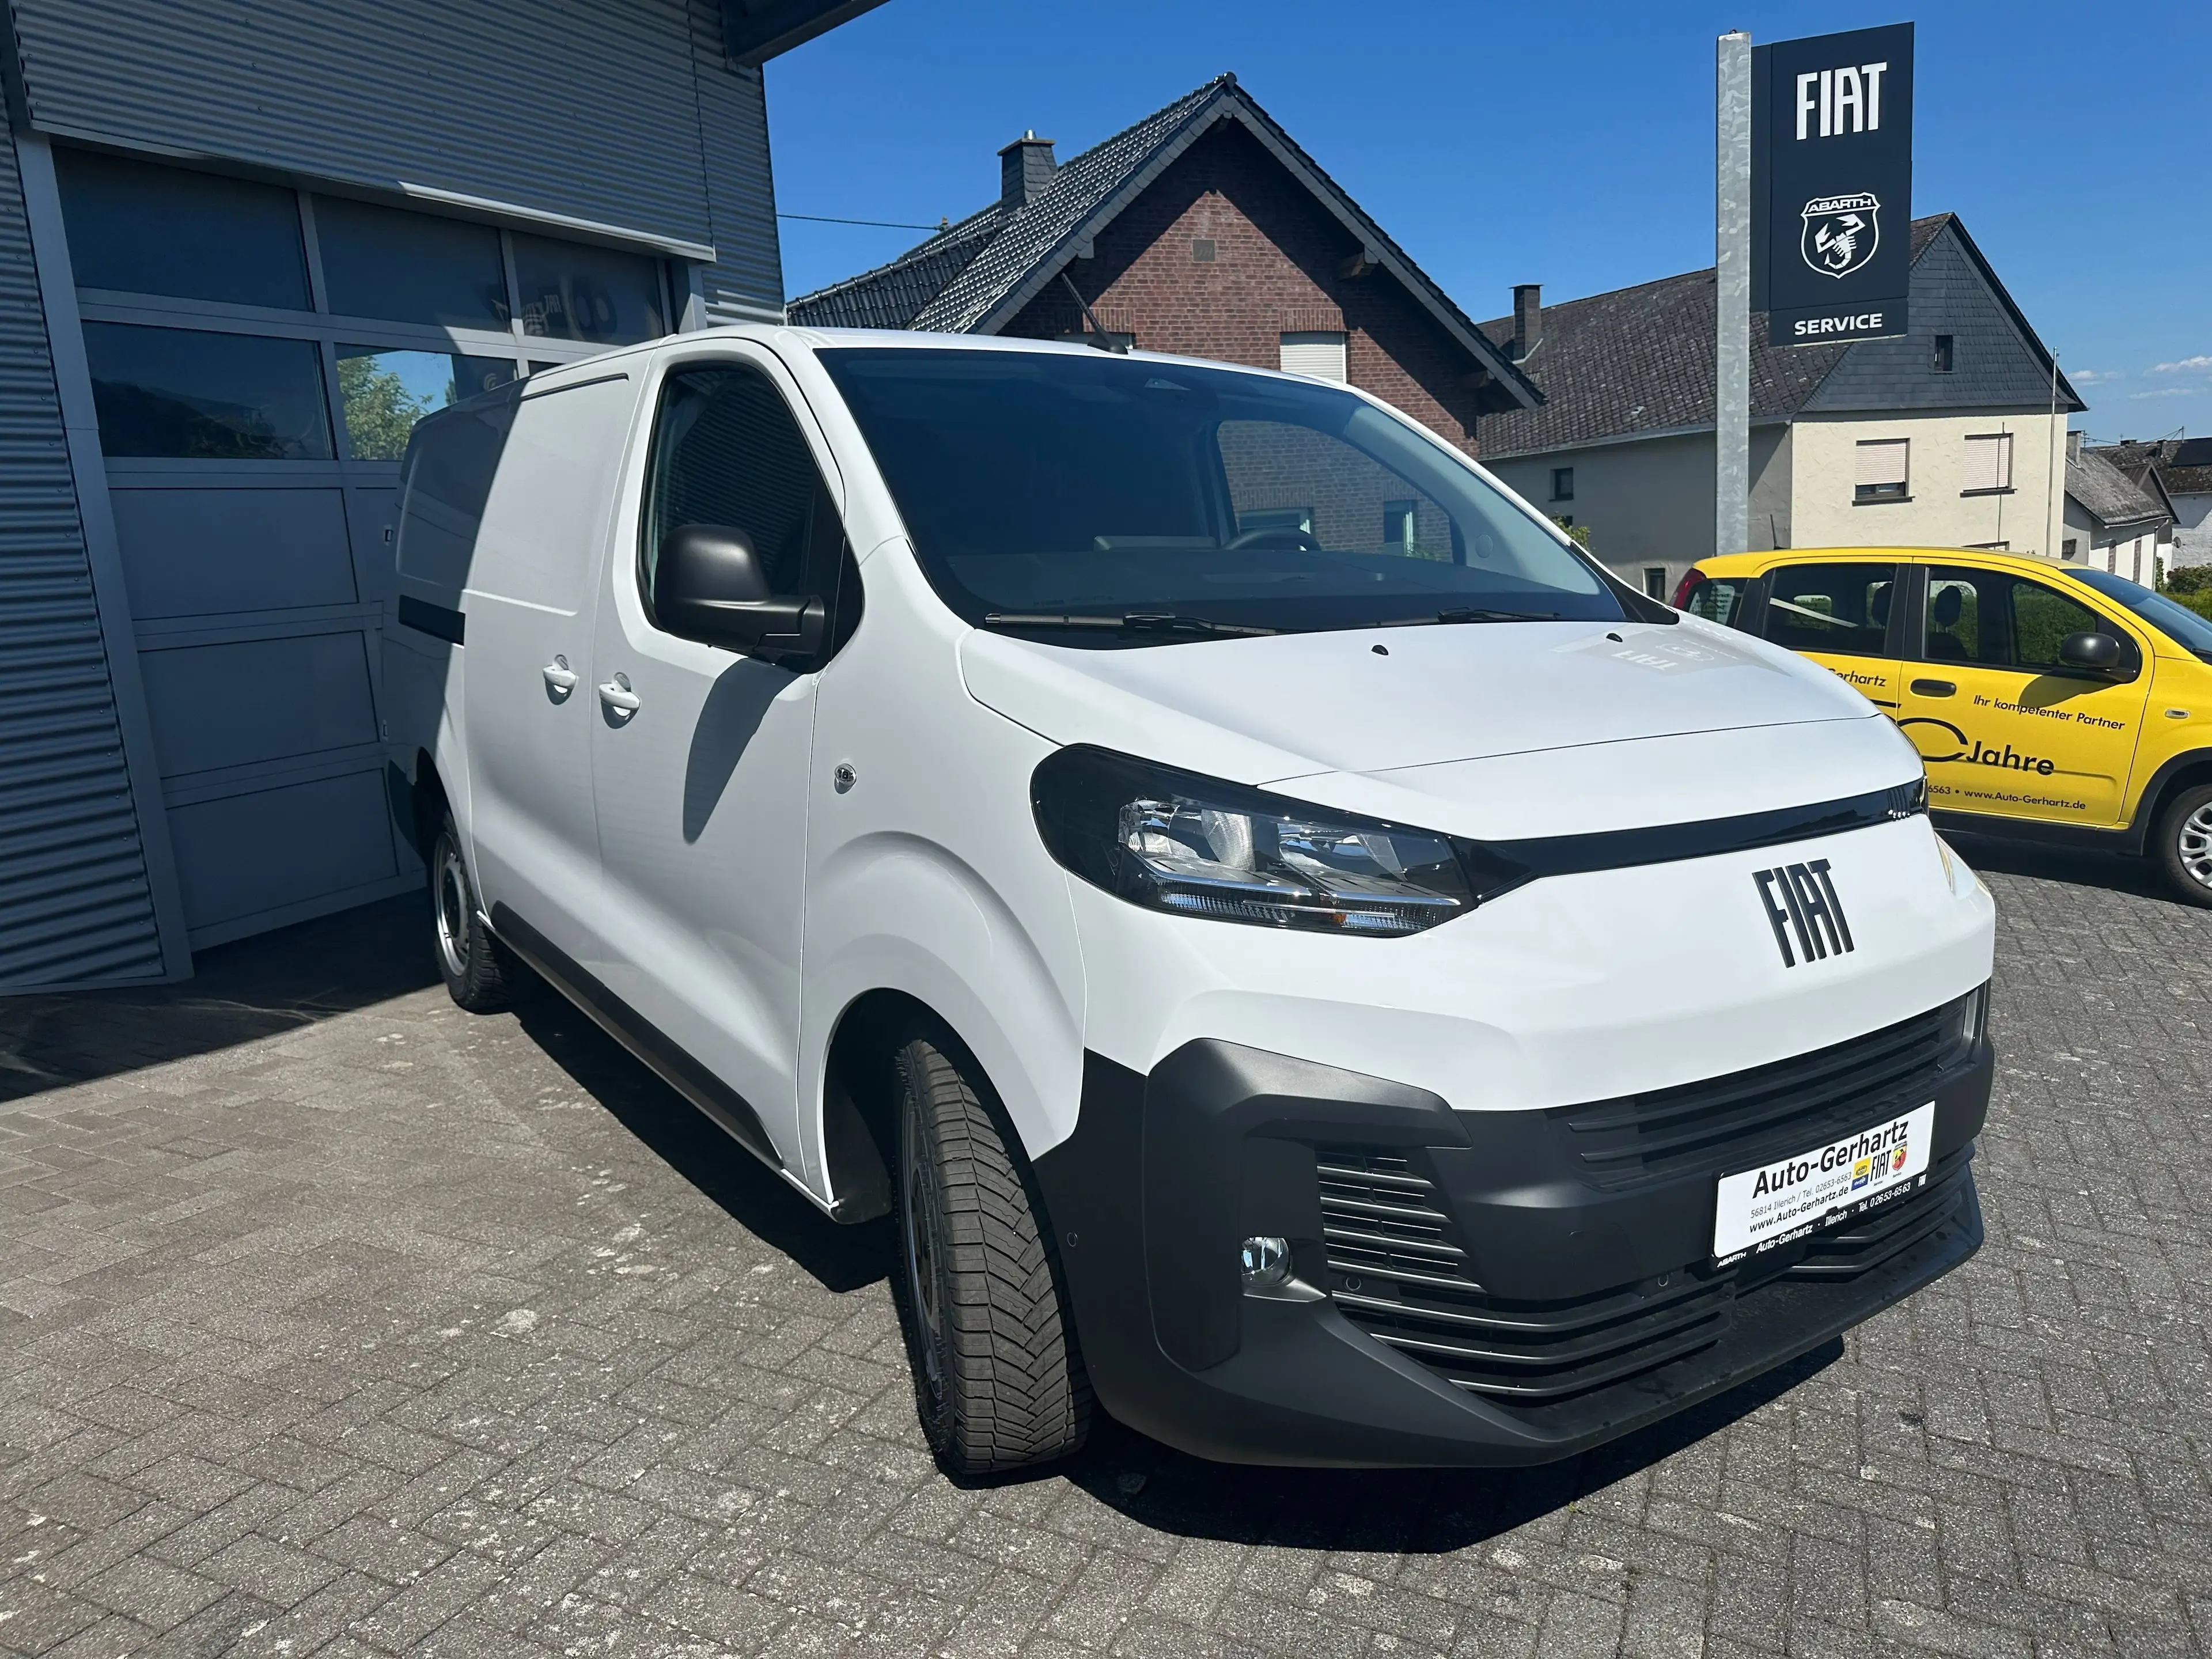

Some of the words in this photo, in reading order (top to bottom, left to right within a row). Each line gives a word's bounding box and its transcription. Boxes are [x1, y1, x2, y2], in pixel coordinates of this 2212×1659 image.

[1796, 62, 1887, 140] FIAT
[1808, 198, 1872, 213] ABARTH
[1794, 313, 1883, 336] SERVICE
[1973, 695, 1991, 707] Ihr
[1993, 698, 2073, 721] kompetenter
[2076, 712, 2126, 730] Partner
[1965, 740, 2055, 776] Jahre
[1928, 785, 1951, 794] 6563
[1964, 790, 2086, 809] www.Auto-Gerhartz.de
[1751, 858, 1855, 968] FIAT
[1752, 1120, 1909, 1199] Auto-Gerhartz
[1870, 1149, 1892, 1181] FIAT
[1749, 1185, 1849, 1233] www.Auto-Gerhartz.de
[1750, 1203, 1772, 1219] 56814
[1773, 1195, 1796, 1210] Illerich
[1802, 1188, 1813, 1199] Tel.
[1815, 1171, 1853, 1194] 02653-6563
[1717, 1251, 1747, 1268] ABARTH
[1755, 1224, 1814, 1254] Auto-Gerhartz
[1824, 1210, 1847, 1227] Illerich
[1869, 1181, 1911, 1208] 02653-6563
